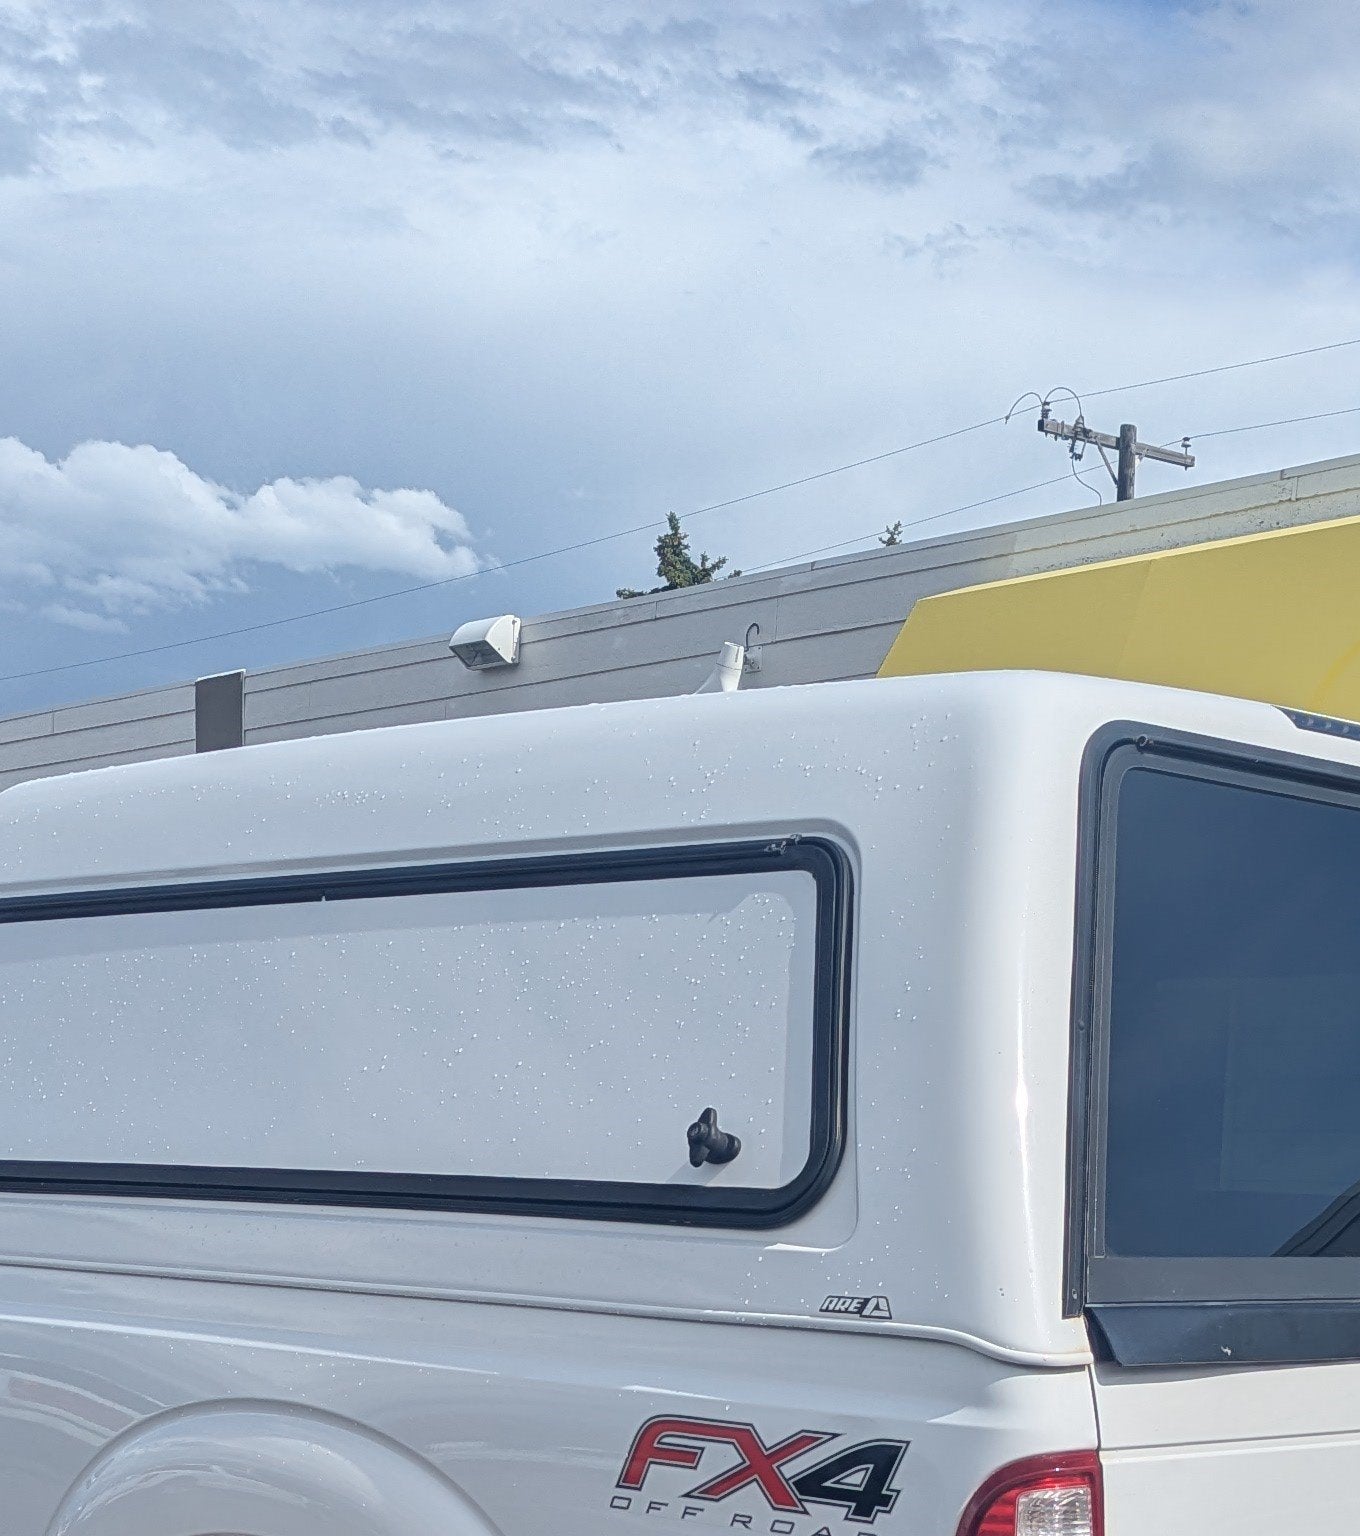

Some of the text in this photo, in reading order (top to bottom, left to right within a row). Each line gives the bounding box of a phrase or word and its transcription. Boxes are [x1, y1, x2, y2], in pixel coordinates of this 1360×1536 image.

[821, 1296, 864, 1313] ARE
[615, 1414, 911, 1524] FX4
[609, 1496, 704, 1520] OFF
